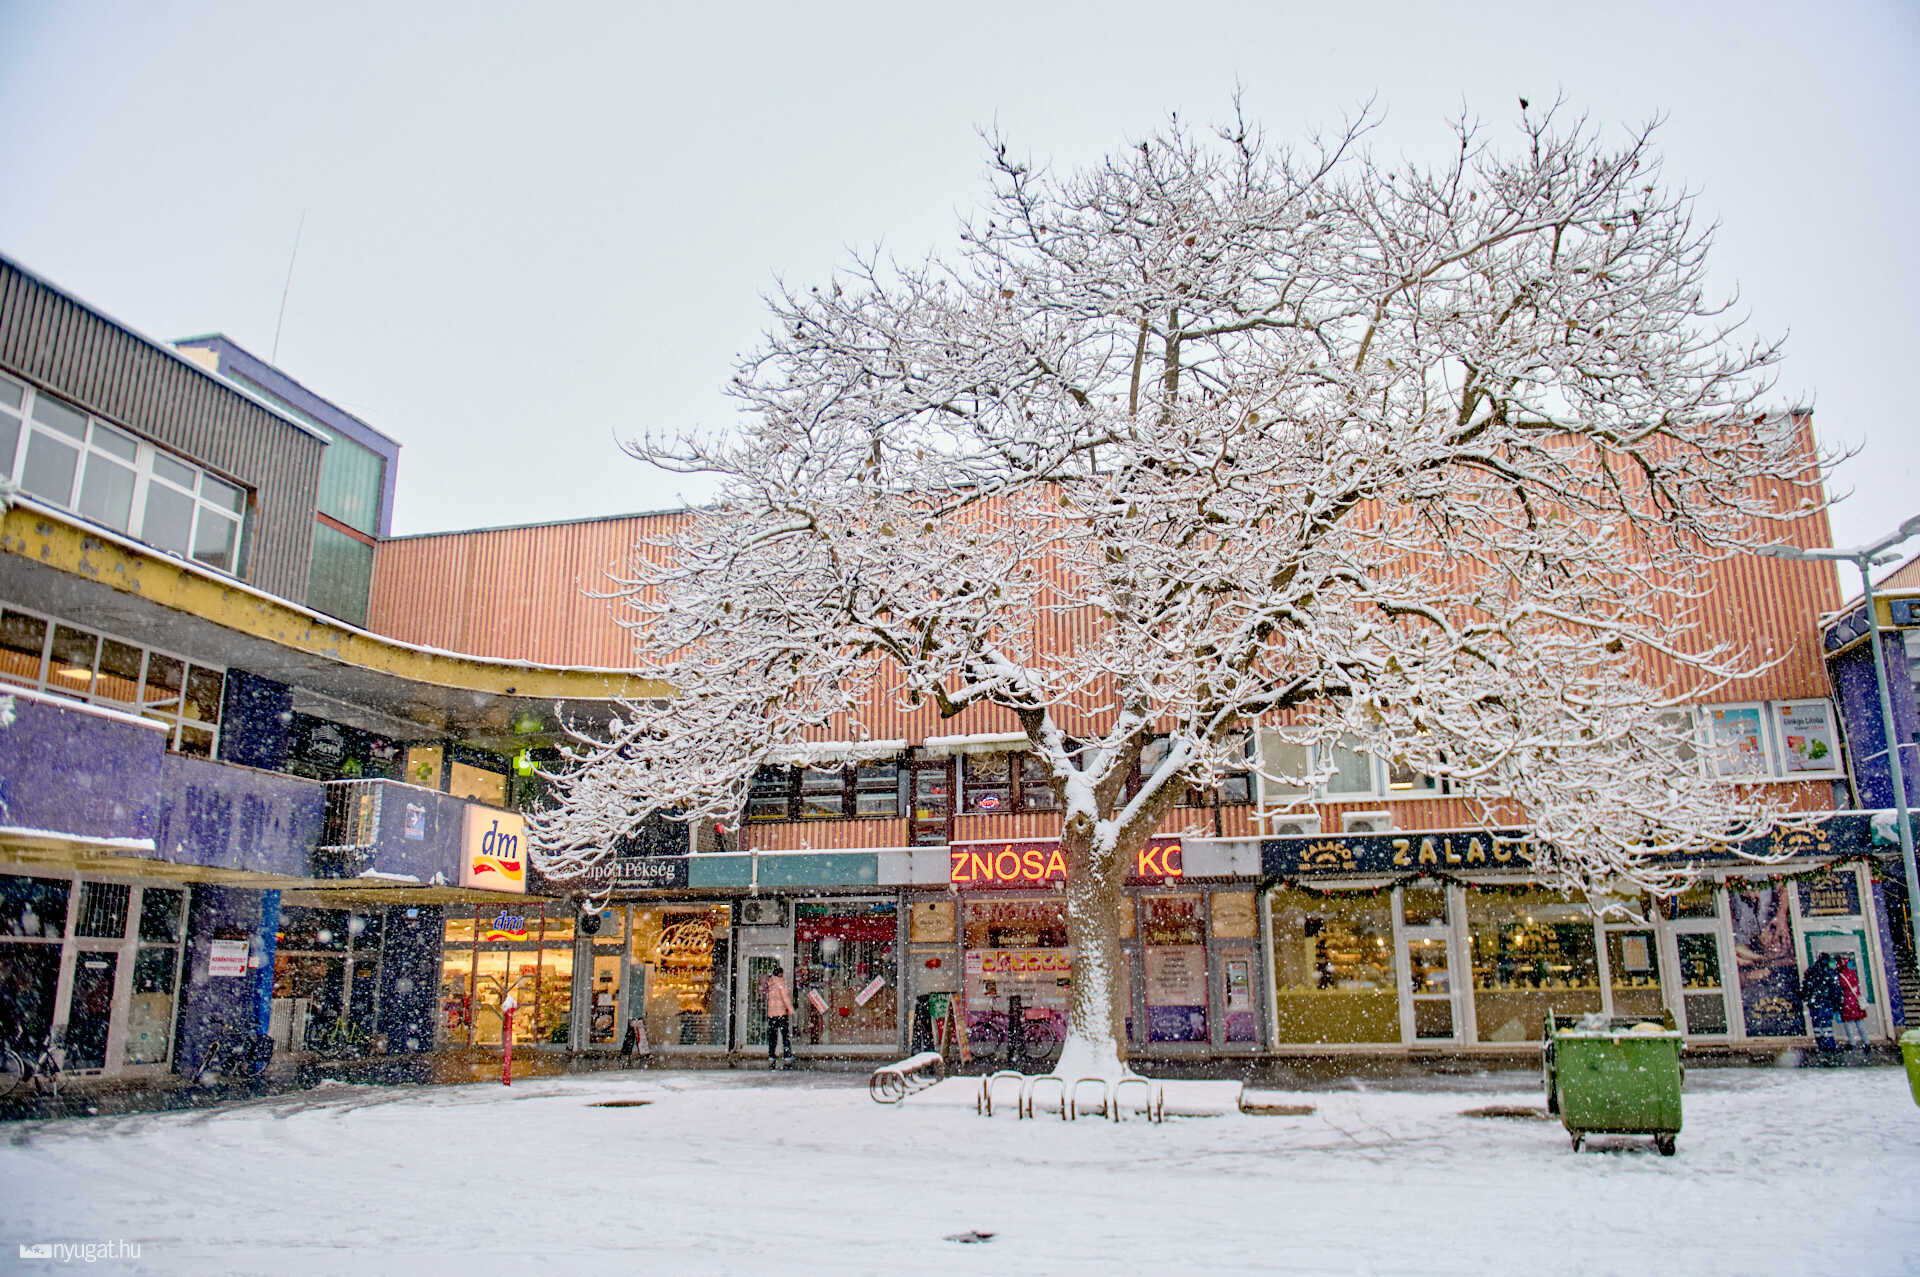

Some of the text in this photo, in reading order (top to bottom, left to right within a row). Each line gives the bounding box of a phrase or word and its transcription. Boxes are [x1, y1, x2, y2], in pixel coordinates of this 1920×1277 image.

[482, 820, 518, 859] dm
[625, 861, 675, 879] Pékség
[493, 911, 524, 930] dm
